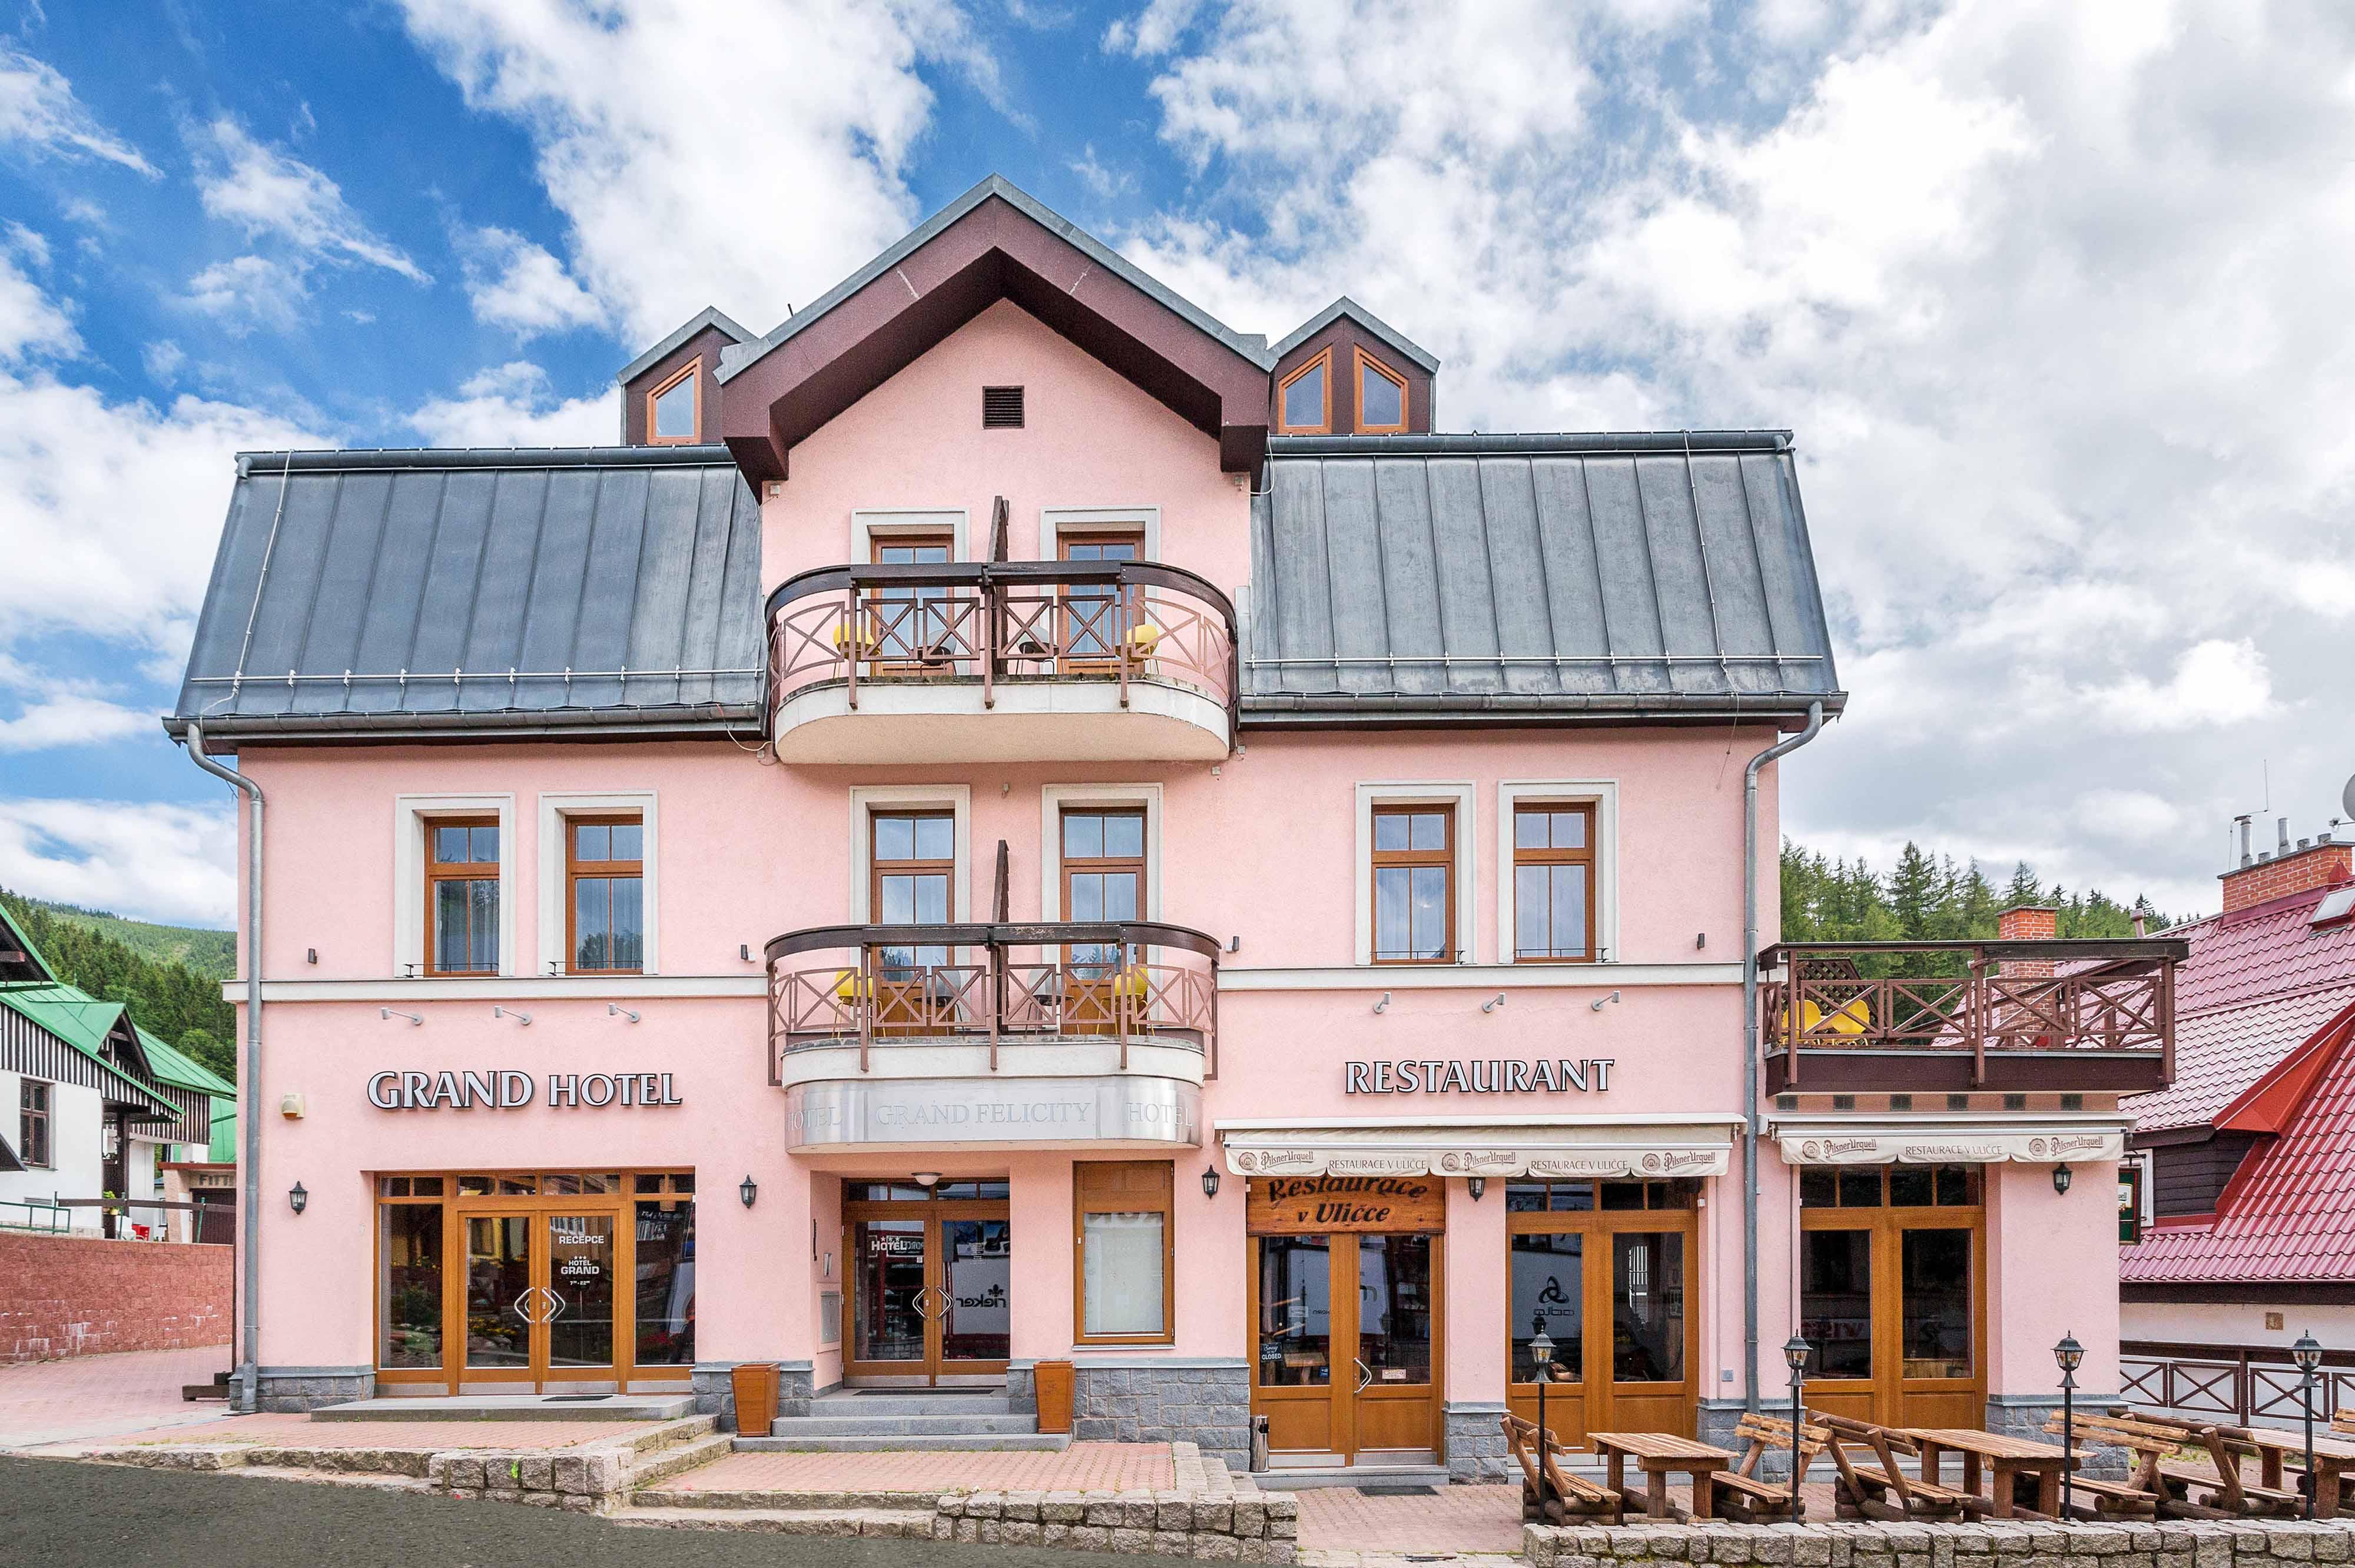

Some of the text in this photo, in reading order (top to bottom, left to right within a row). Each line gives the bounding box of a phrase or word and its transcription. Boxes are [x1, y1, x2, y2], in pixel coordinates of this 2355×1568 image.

[1345, 1059, 1615, 1094] RESTAURANT
[367, 1070, 683, 1109] GRAND HOTEL
[787, 1102, 1192, 1131] HOTEL GRAND FELICITY HOTEL
[1823, 1138, 1876, 1158] Pilsner Urquell
[1905, 1144, 2002, 1155] RESTAURACE V ULIČCE
[2051, 1135, 2103, 1157] Pilsner Urquell
[1261, 1150, 1314, 1170] Pilsner Urquell
[1329, 1158, 1427, 1169] RESTAURACE V ULIČCE
[1464, 1151, 1516, 1171] Pilsner Urquell
[1531, 1158, 1628, 1170] RESTAURACE V ULIČCE
[1664, 1151, 1715, 1171] Pilsner Urquell
[1269, 1177, 1428, 1202] Restaurace
[1298, 1202, 1390, 1224] v Uličce
[559, 1235, 604, 1244] RECEPCE
[871, 1240, 907, 1251] HOTEL
[560, 1266, 600, 1274] GRAND
